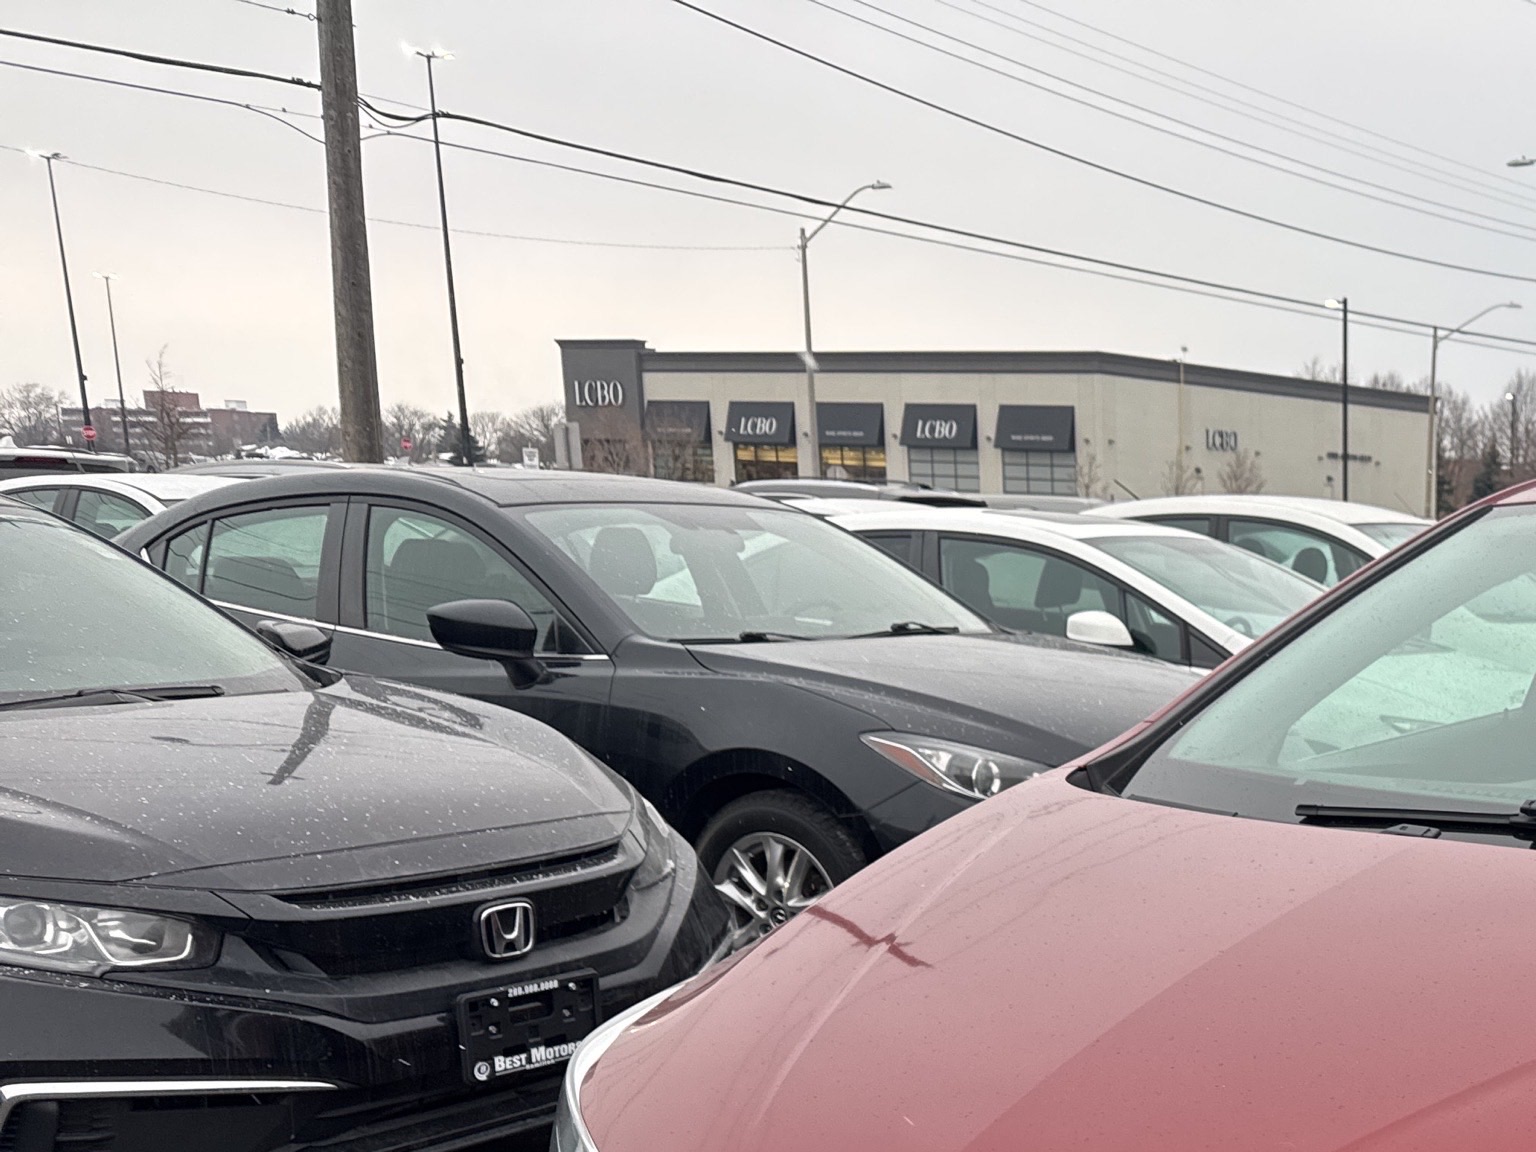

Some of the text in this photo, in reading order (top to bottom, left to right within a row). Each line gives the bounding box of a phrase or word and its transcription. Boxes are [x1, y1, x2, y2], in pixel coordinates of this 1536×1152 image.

[574, 380, 623, 407] LCBO
[739, 416, 777, 436] LCBO
[916, 418, 957, 439] LCBO
[1205, 428, 1238, 451] LCBO
[493, 1053, 527, 1072] BEST
